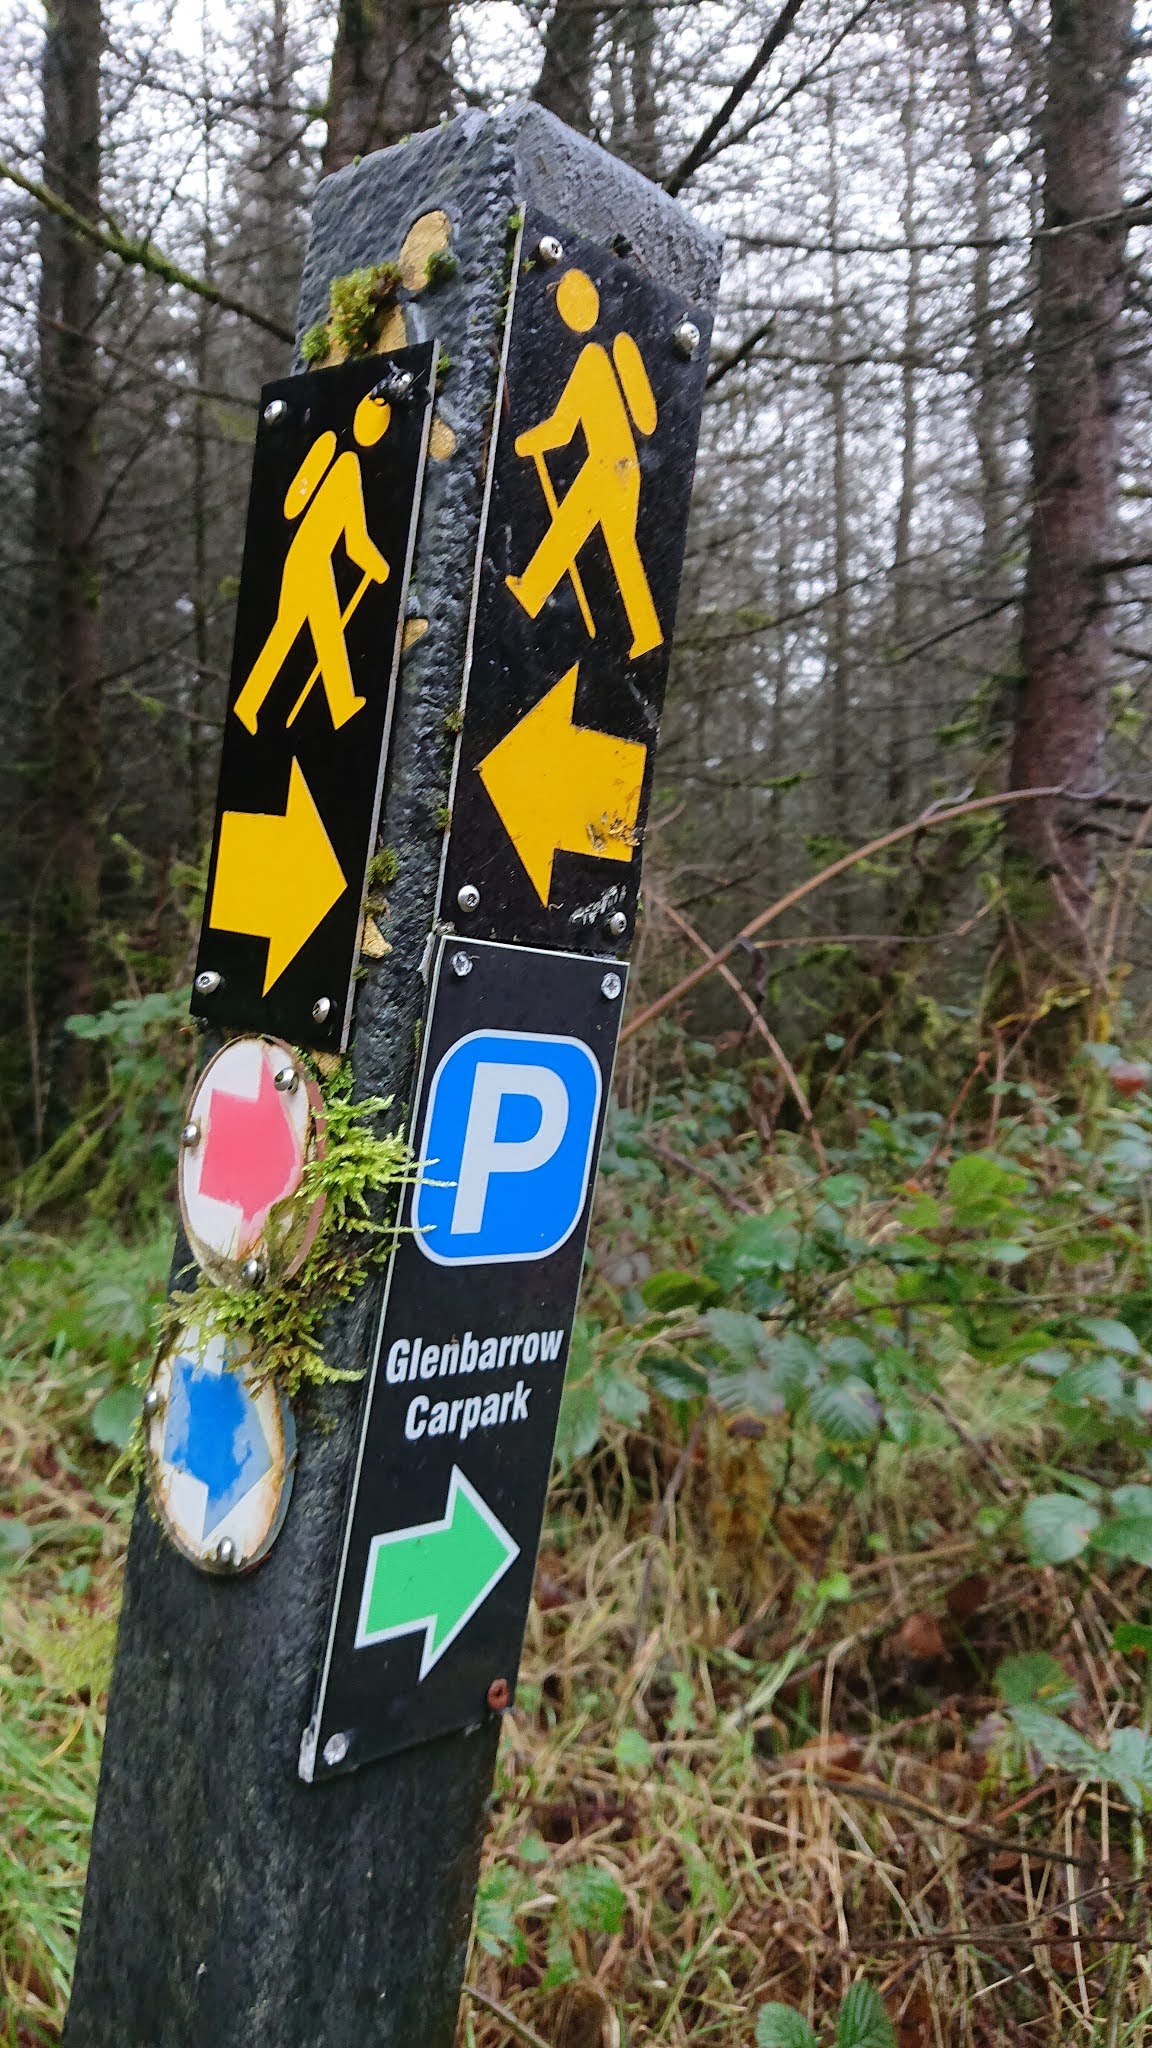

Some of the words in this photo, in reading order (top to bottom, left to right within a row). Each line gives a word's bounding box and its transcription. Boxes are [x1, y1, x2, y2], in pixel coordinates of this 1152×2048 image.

[451, 1062, 569, 1235] P
[385, 1329, 564, 1385] Glenbarrow
[404, 1380, 532, 1441] Carpark
